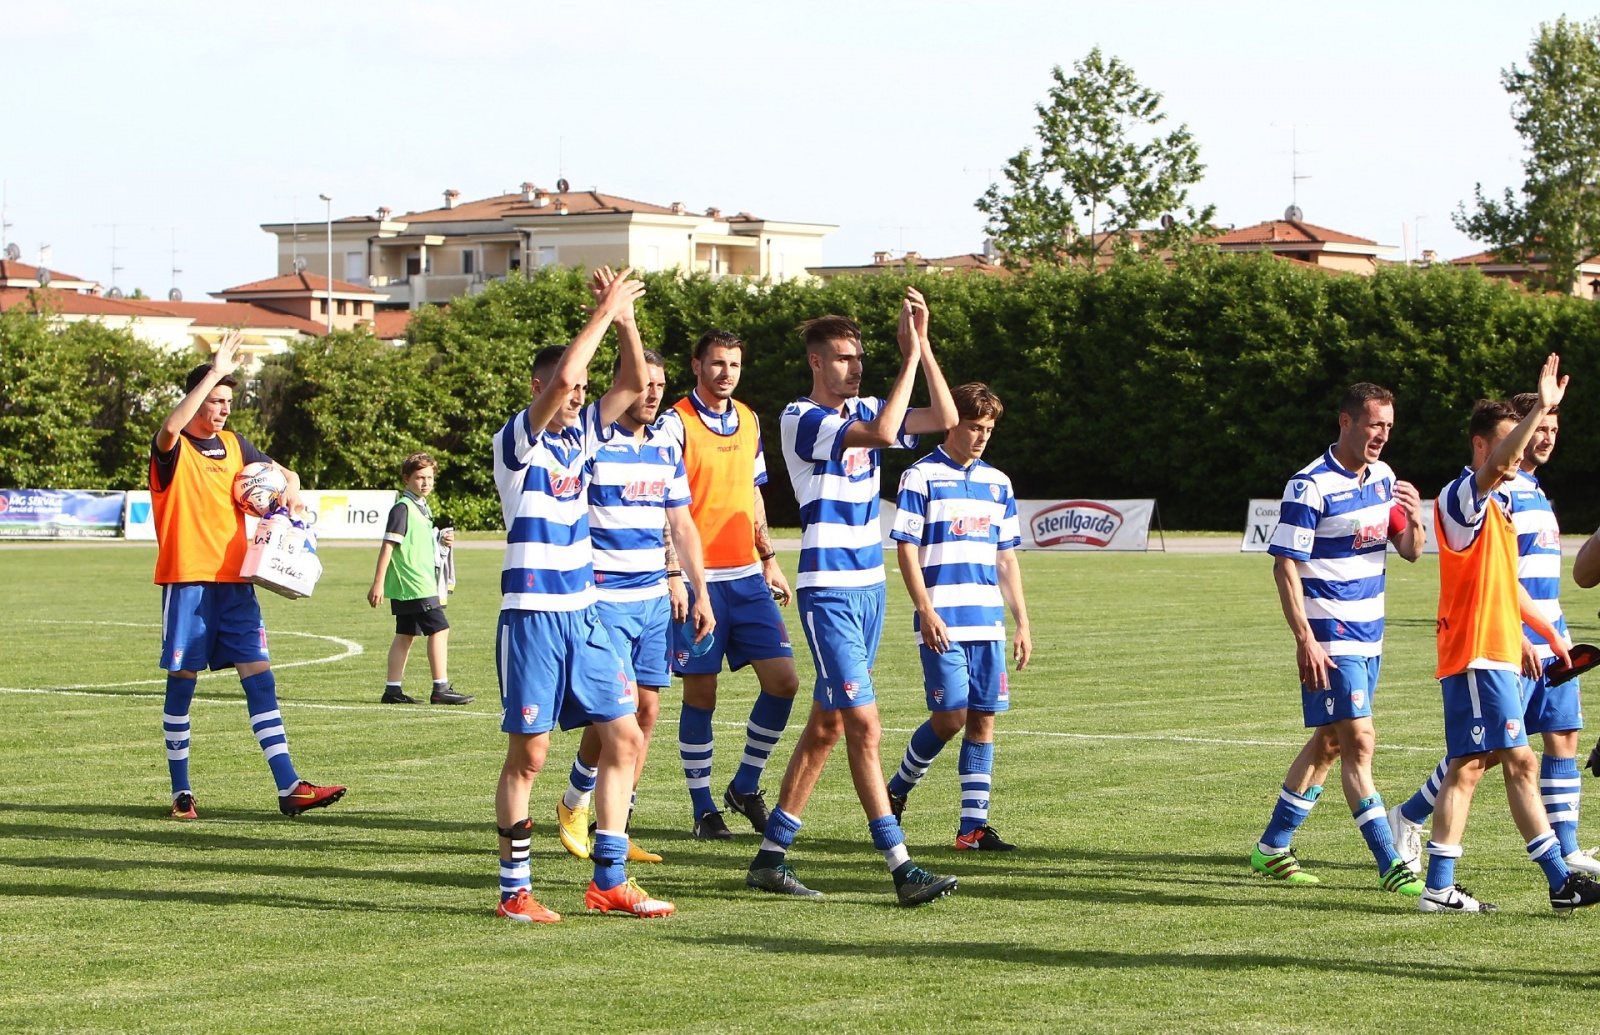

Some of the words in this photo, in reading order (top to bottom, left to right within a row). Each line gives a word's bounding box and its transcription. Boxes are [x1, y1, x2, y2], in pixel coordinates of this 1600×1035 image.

[240, 476, 268, 490] molten
[9, 495, 27, 506] MG
[1037, 509, 1115, 537] sterilgarda
[269, 557, 304, 580] Sixtus
[526, 573, 535, 588] 2
